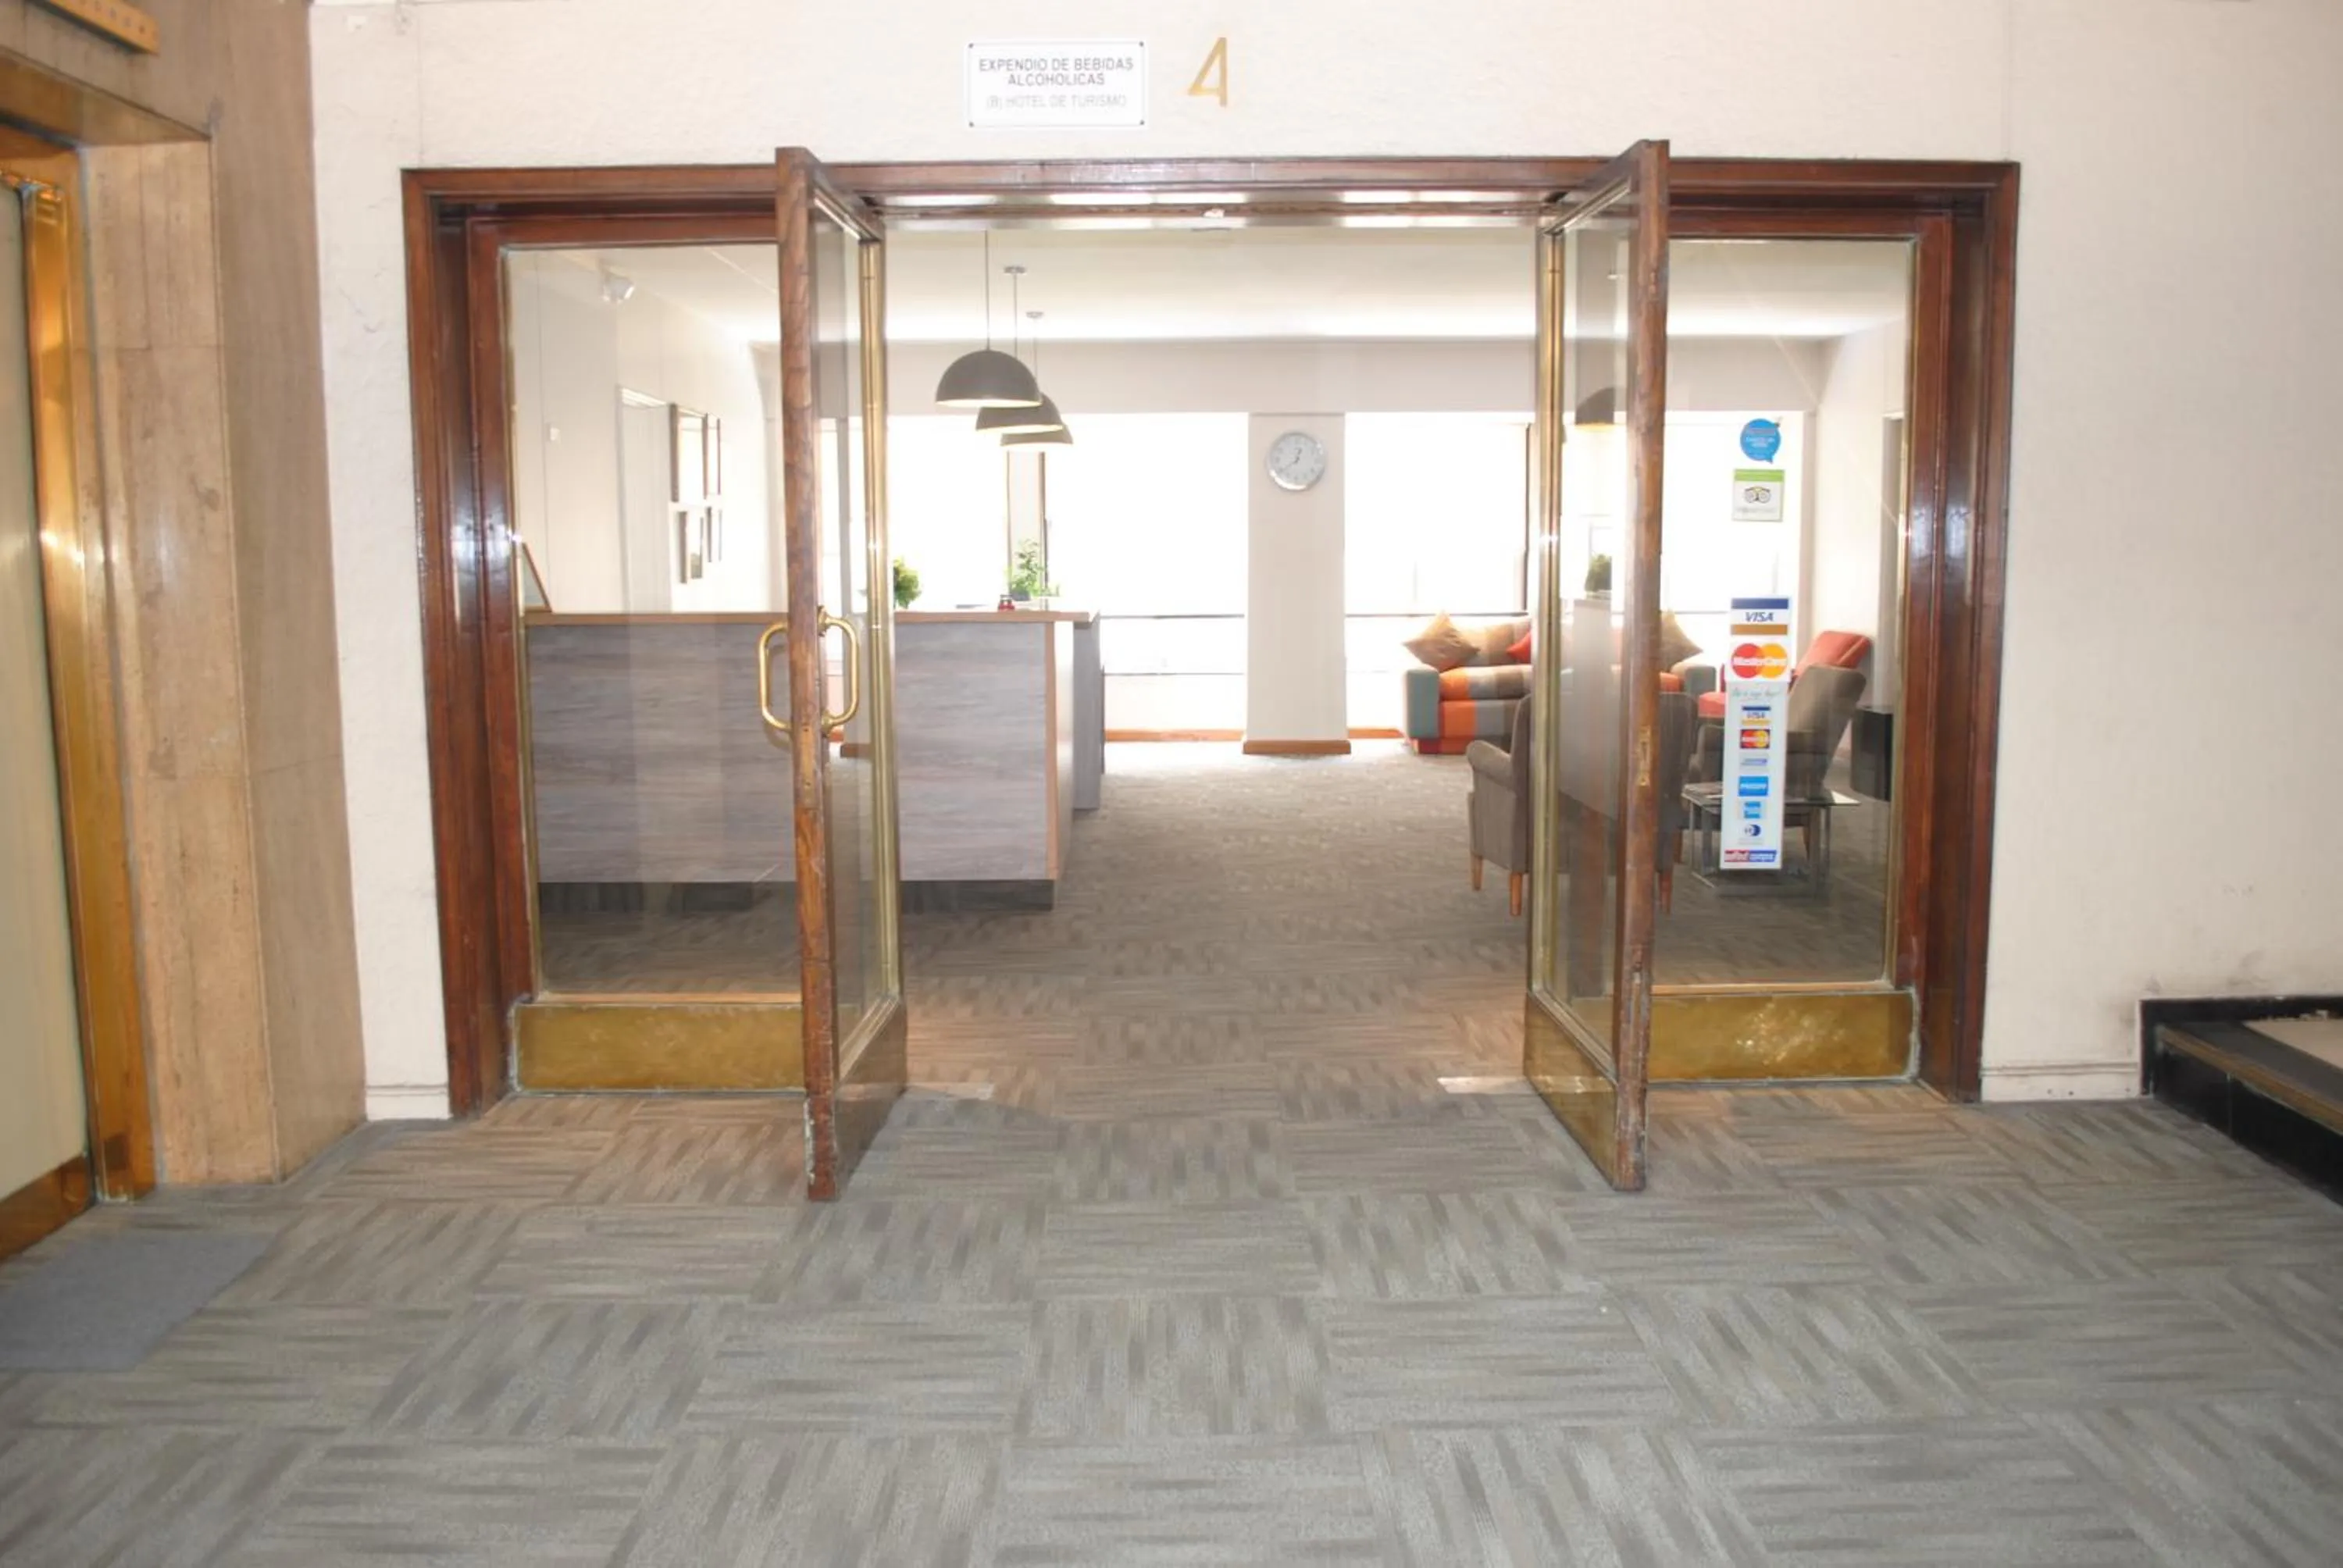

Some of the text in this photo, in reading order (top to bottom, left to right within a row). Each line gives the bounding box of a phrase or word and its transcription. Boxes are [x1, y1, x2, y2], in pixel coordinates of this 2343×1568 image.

[979, 57, 1134, 72] EXPENDIO DE BEBIDAS
[1187, 37, 1227, 107] 4
[1007, 73, 1105, 86] ALCOHOLICAS
[1006, 94, 1047, 108] HOTEL
[1049, 94, 1067, 108] DE
[1072, 94, 1127, 108] TURISMO
[1745, 612, 1774, 622] VISA
